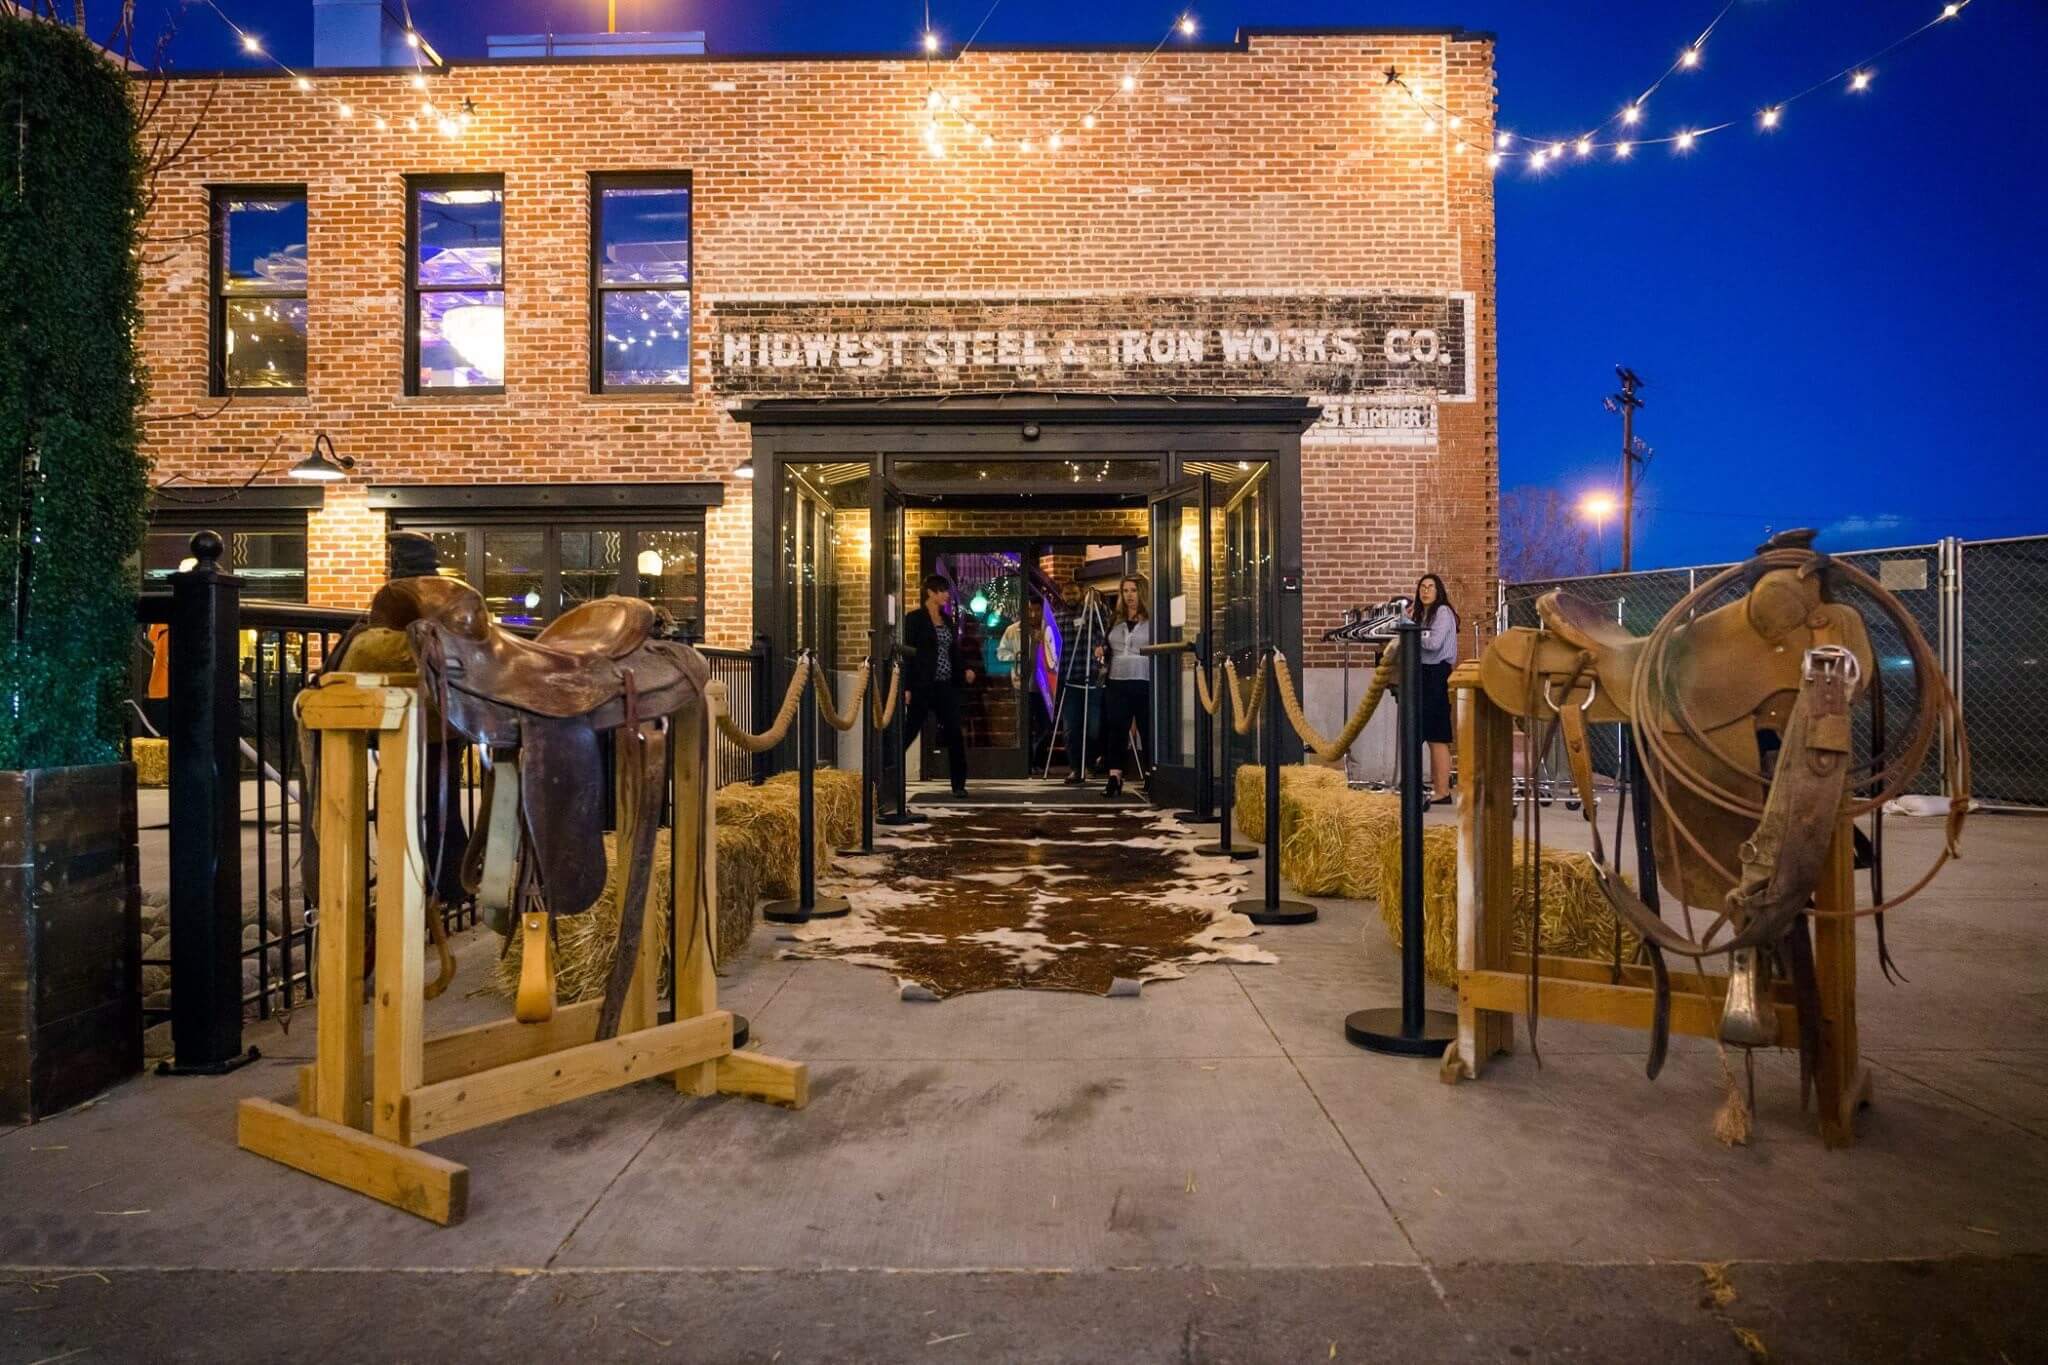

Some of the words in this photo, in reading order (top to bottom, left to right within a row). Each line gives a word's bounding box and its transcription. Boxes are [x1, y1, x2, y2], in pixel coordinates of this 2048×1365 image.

[723, 332, 909, 368] MIDWEST
[924, 332, 1046, 366] STEEL
[1109, 330, 1204, 364] IRON
[1218, 329, 1364, 363] WORKS
[1382, 328, 1452, 365] CO.
